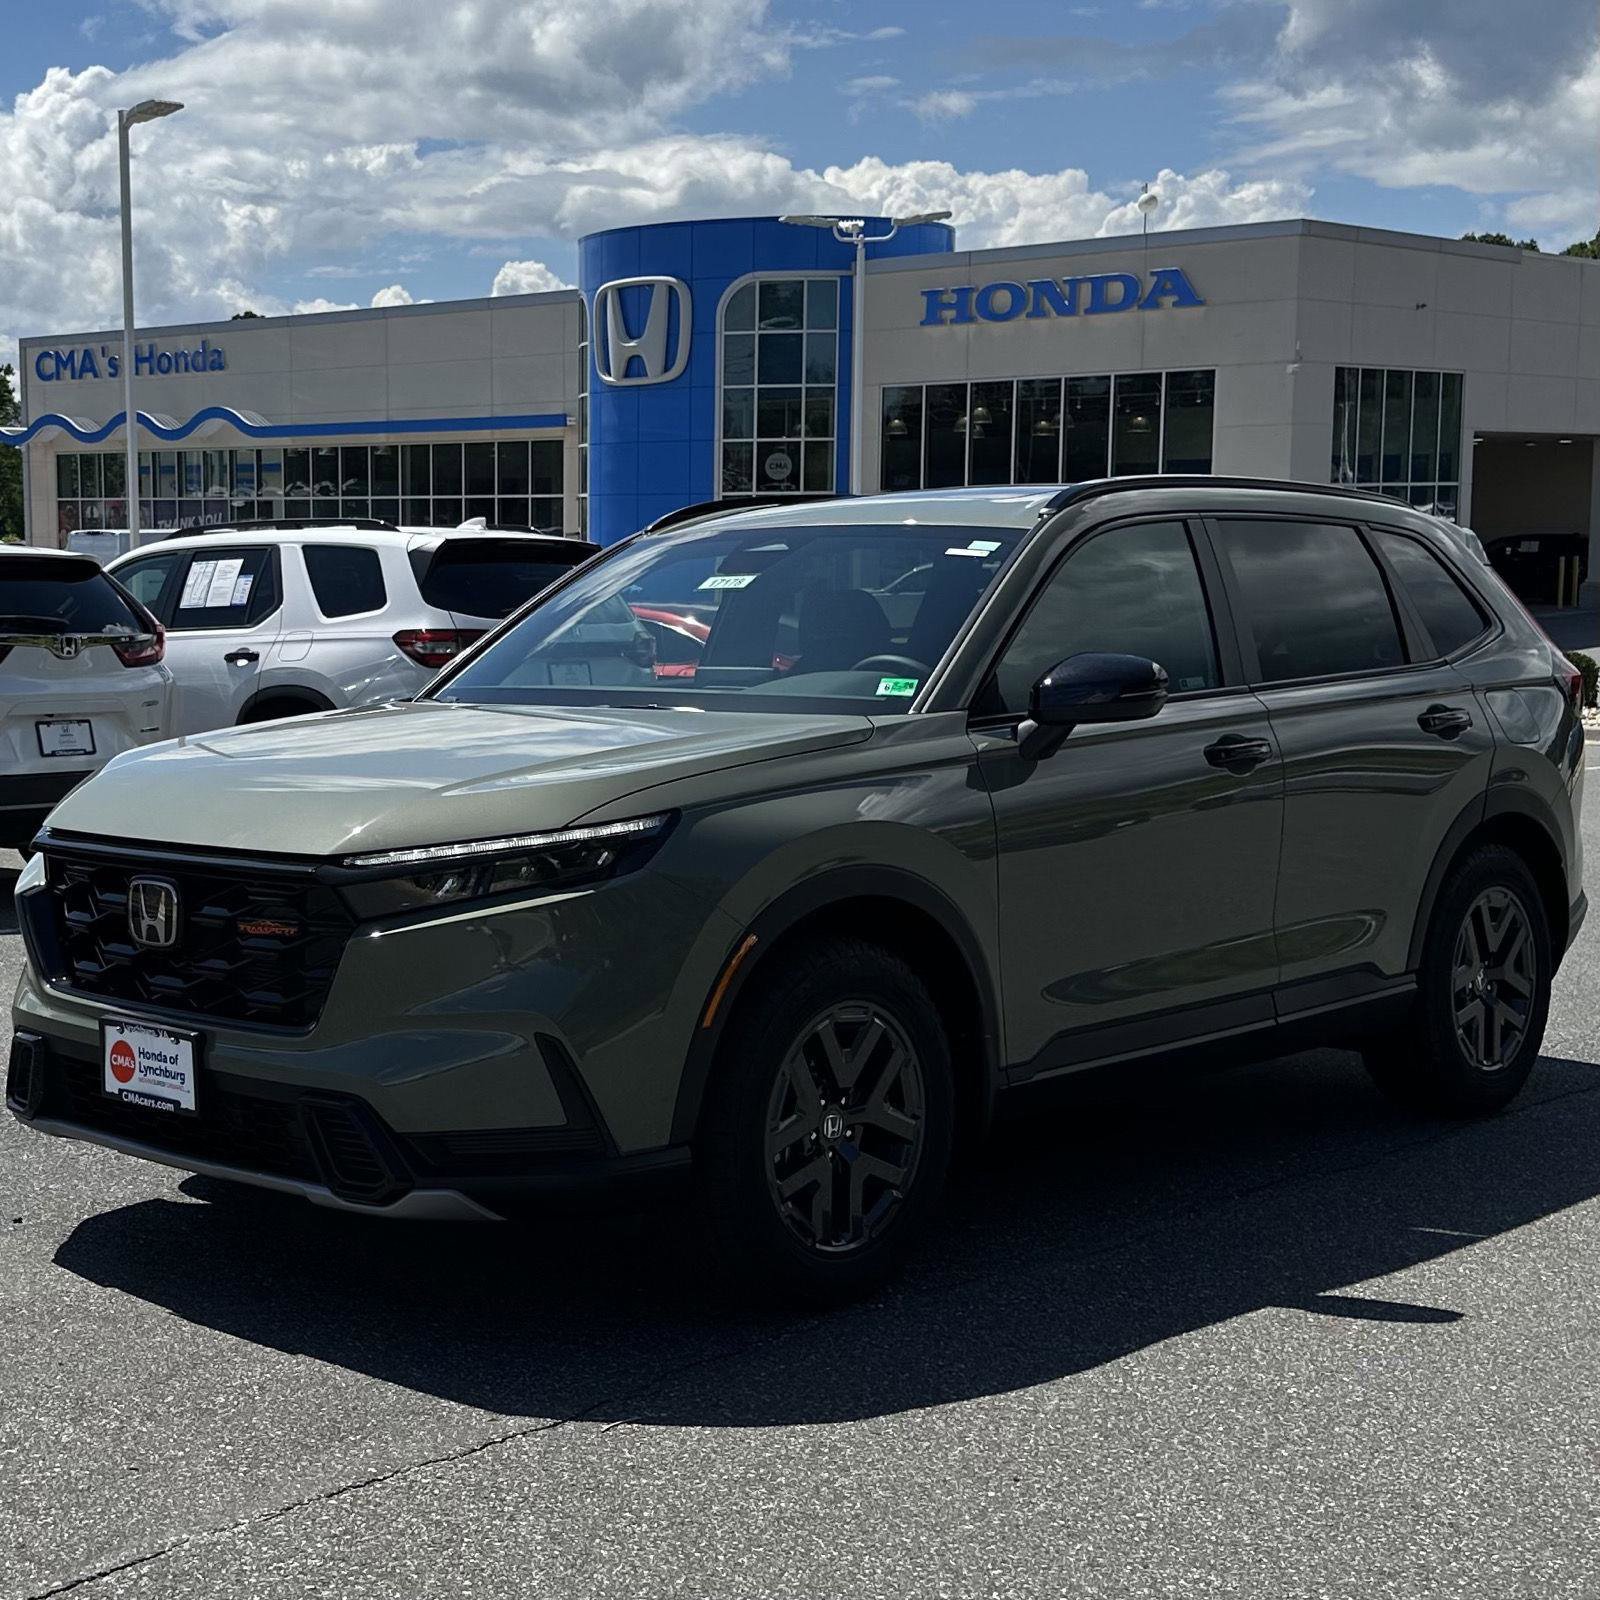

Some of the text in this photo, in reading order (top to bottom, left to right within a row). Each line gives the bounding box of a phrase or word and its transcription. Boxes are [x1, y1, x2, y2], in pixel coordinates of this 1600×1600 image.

[919, 267, 1206, 326] HONDA
[35, 340, 225, 382] CMA's Honda
[157, 516, 195, 529] THANK
[111, 1053, 136, 1069] CMA's
[138, 1046, 179, 1066] Honda of
[138, 1061, 186, 1086] Lynchburg
[122, 1091, 175, 1113] CMAcars.com
